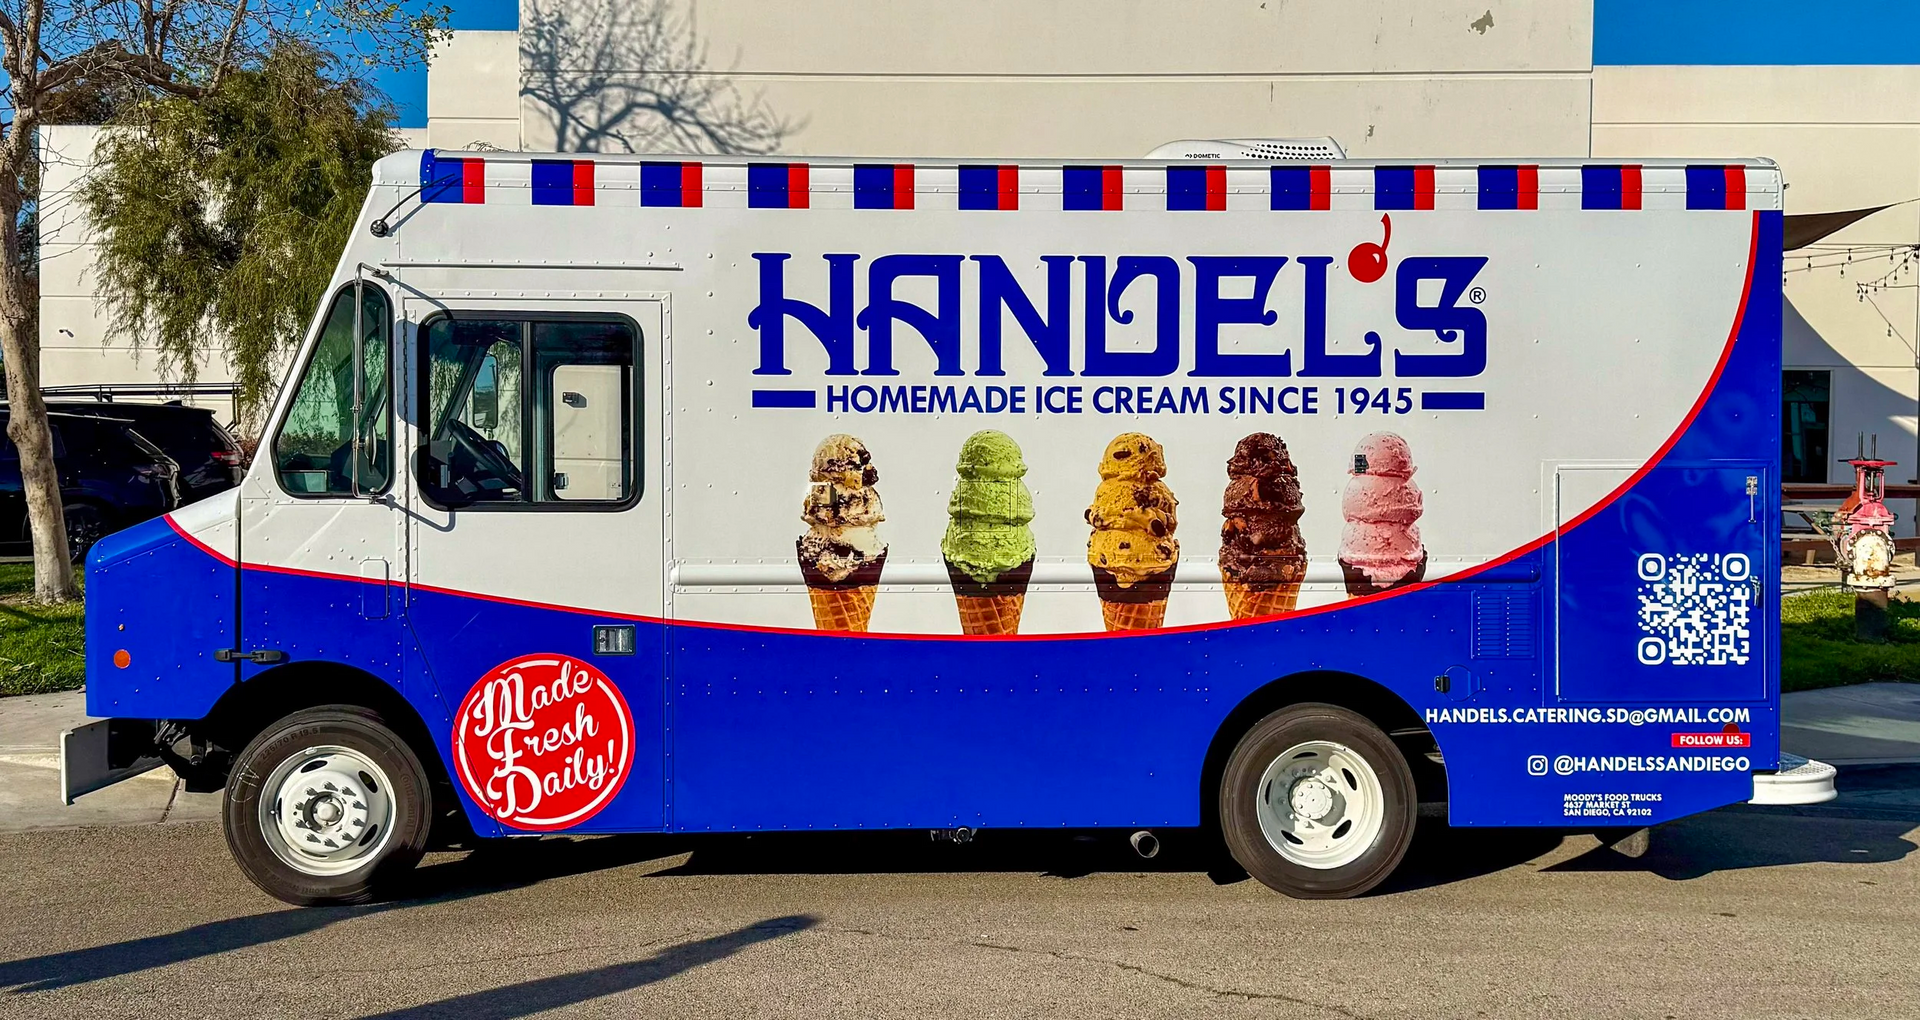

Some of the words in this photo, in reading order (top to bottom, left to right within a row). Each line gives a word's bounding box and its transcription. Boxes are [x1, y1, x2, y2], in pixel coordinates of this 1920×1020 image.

[827, 385, 1026, 413] HOMEMADE
[1035, 386, 1083, 413] ICE
[1093, 386, 1210, 414] CREAM
[1219, 387, 1318, 414] SINCE
[1335, 387, 1413, 415] 1945
[473, 660, 593, 737] Made
[1426, 708, 1751, 726] HANDELS.CATERING.SD@GMAIL.COM
[487, 702, 600, 778] Fresh
[1680, 735, 1724, 745] FOLLOW
[1726, 735, 1743, 745] US:
[1553, 755, 1750, 776] @HANDELSSANDIEGO
[486, 739, 615, 818] Daily!
[1563, 801, 1584, 809] 4637
[1586, 801, 1620, 809] MARKET
[1622, 801, 1631, 809] ST
[1564, 794, 1603, 802] MOODY'S
[1605, 794, 1629, 802] FOOD
[1630, 794, 1662, 802] TRUCKS
[1583, 809, 1611, 817] DIEGO,
